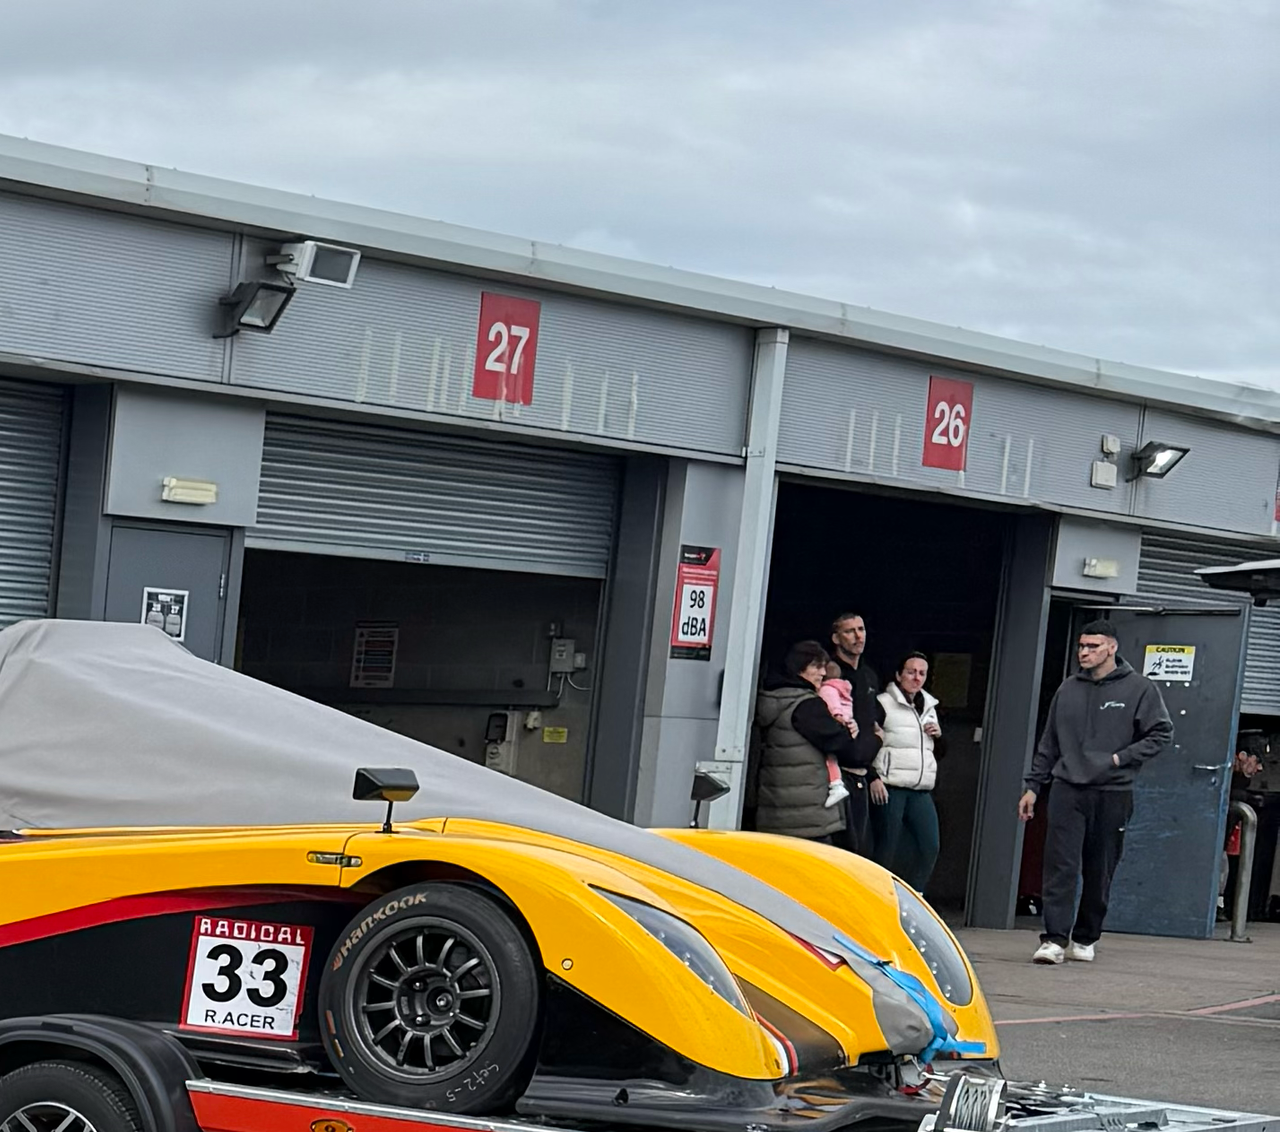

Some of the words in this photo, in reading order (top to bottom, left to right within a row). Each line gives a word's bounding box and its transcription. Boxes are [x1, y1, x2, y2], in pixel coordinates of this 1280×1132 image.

[484, 321, 530, 375] 27
[931, 400, 966, 448] 26
[689, 590, 705, 609] 98
[682, 616, 706, 637] dBA
[200, 918, 305, 944] RADICAL
[202, 944, 289, 1008] 33
[204, 1009, 275, 1030] R.ACER
